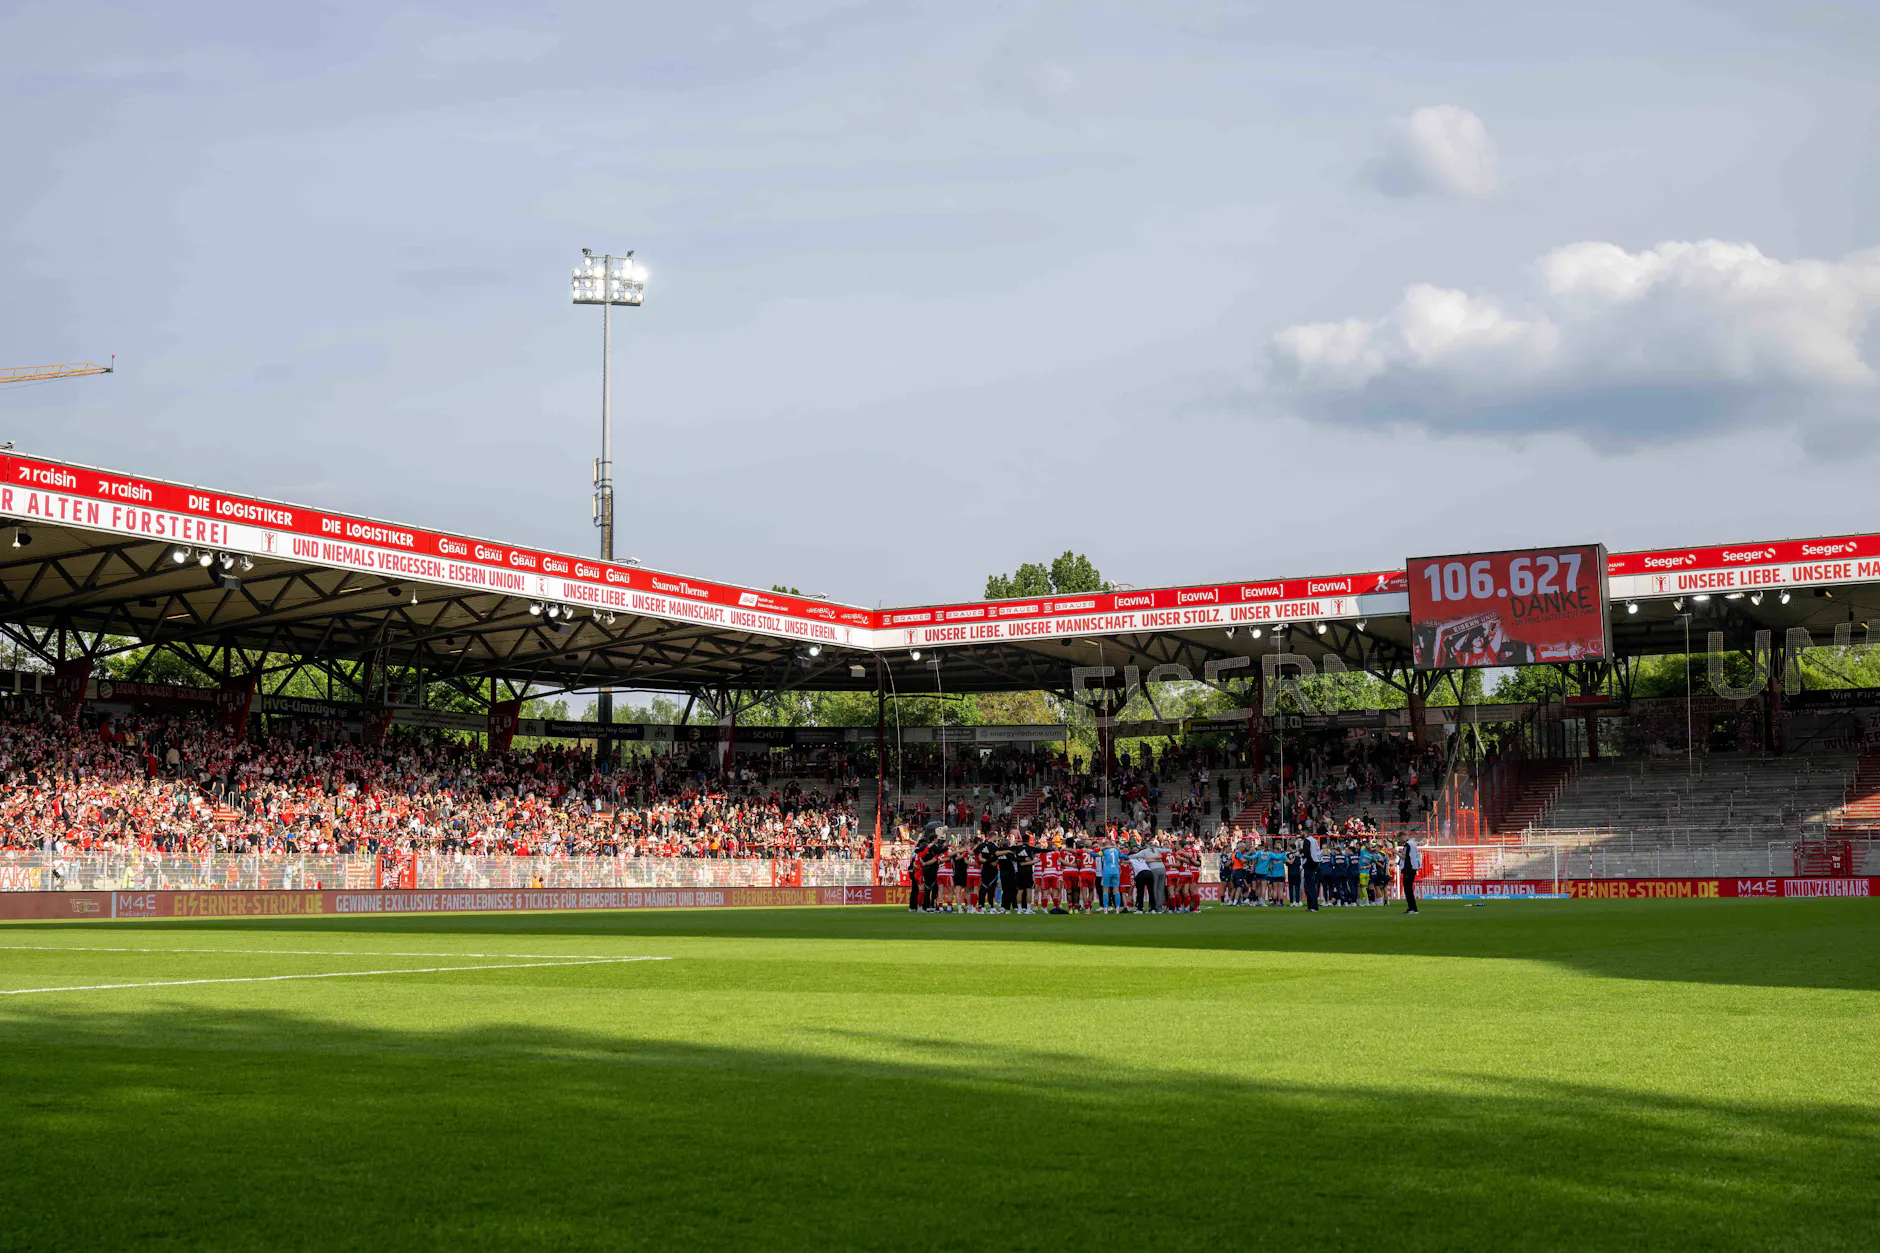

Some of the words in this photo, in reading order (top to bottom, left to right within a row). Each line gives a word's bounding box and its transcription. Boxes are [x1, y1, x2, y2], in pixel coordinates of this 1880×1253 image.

[33, 467, 77, 489] raisin
[111, 481, 153, 502] raisin
[27, 492, 100, 525] ALTEN
[112, 506, 228, 545] FÖRSTEREI
[189, 494, 210, 512] DIE
[216, 500, 293, 526] LOGISTIKER
[322, 518, 341, 534] DIE
[346, 522, 414, 547] LOGISTIKER
[1722, 550, 1763, 562] Seeger
[1801, 543, 1844, 555] Seeger
[293, 538, 319, 558] UND
[323, 542, 375, 567] NIEMALS
[378, 551, 445, 579] VERGESSEN:
[449, 564, 486, 584] EISERN
[489, 570, 525, 591] UNION!
[1644, 557, 1684, 568] Seeger
[1424, 553, 1582, 602] 106.627
[1678, 573, 1734, 590] UNSERE
[1740, 568, 1786, 586] LIEBE.
[1792, 563, 1852, 582] UNSERE
[652, 577, 709, 599] SaarowTherme
[1000, 605, 1038, 614] BRAUER
[1055, 601, 1095, 610] BRAUER
[1510, 586, 1593, 618] DANKE
[563, 582, 599, 602] UNSERE
[601, 588, 629, 608] LIEBE.
[632, 593, 666, 614] UNSERE
[668, 599, 725, 624] MANNSCHAFT.
[730, 610, 756, 628] UNSER
[758, 614, 782, 632] STOLZ.
[784, 619, 808, 637] UNSER
[810, 623, 838, 641] VEREIN.
[894, 613, 931, 622] BRAUER
[946, 609, 984, 618] BRAUER
[924, 626, 966, 643] UNSERE
[970, 623, 1004, 640] LIEBE.
[1008, 620, 1052, 637] UNSERE
[1055, 615, 1137, 633] MANNSCHAFT.
[1141, 609, 1180, 627] UNSER
[1183, 605, 1224, 624] STOLZ.
[1230, 604, 1270, 622] UNSER
[1275, 601, 1324, 619] VEREIN.
[263, 697, 337, 717] HVG-Umzüge
[989, 730, 1062, 738] energy-reduce.com
[1046, 854, 1052, 867] 5
[1082, 853, 1094, 864] 20
[1110, 851, 1116, 867] 1
[846, 888, 872, 899] M4E
[1737, 880, 1777, 893] M4E
[119, 894, 156, 910] M4E
[335, 894, 382, 912] GEWINNE
[385, 894, 439, 912] EXKLUSIVE
[441, 893, 514, 911] FANERLEBNISSE
[516, 893, 522, 909] &
[525, 893, 559, 909] TICKETS
[561, 890, 577, 909] FÜR
[579, 892, 626, 909] HEIMSPIELE
[628, 892, 642, 907] DER
[644, 890, 677, 907] MÄNNER
[679, 891, 694, 906] UND
[695, 891, 724, 906] FRAUEN
